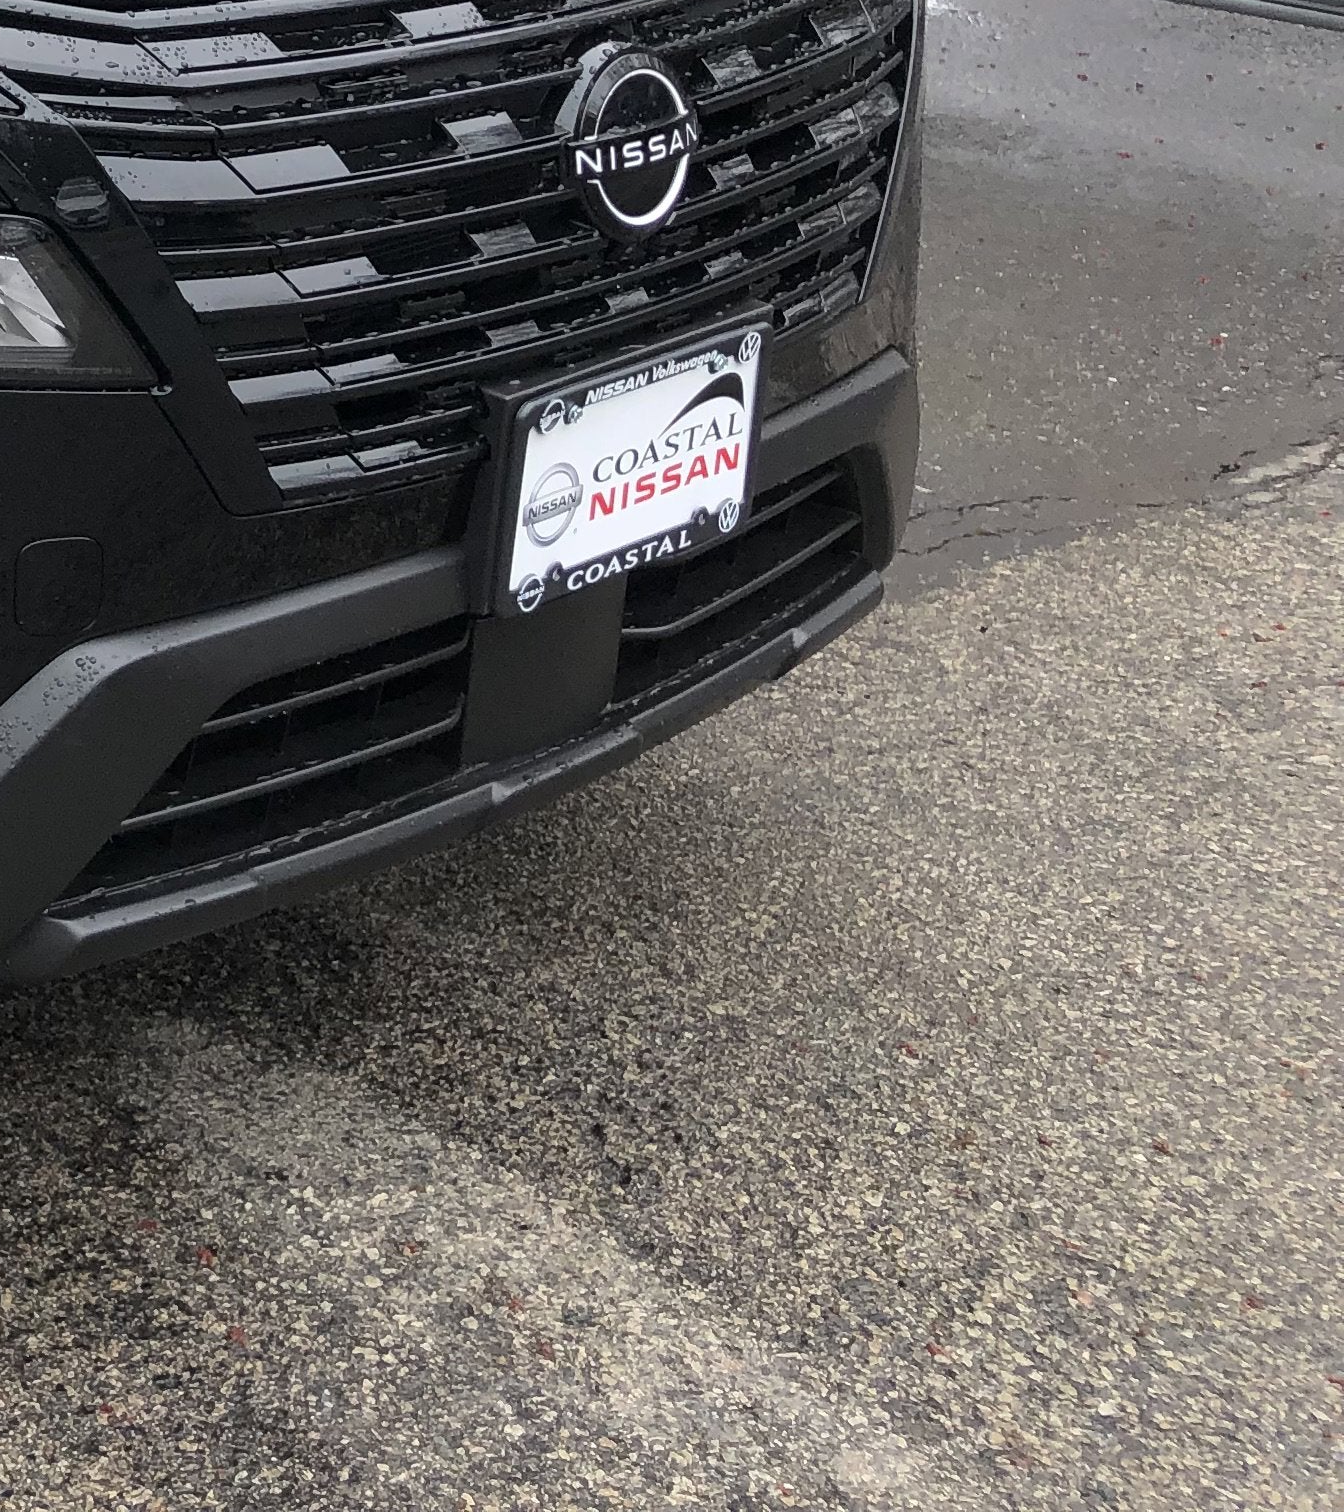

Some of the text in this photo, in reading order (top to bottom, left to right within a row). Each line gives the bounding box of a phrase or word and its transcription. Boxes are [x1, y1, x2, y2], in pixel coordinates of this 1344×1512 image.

[575, 122, 699, 176] NISSAN
[584, 350, 718, 406] NISSAN Volkswagen
[593, 412, 743, 483] COASTAL
[528, 490, 577, 520] NISSAN
[589, 442, 741, 522] NISSAN
[566, 529, 692, 591] COASTAL
